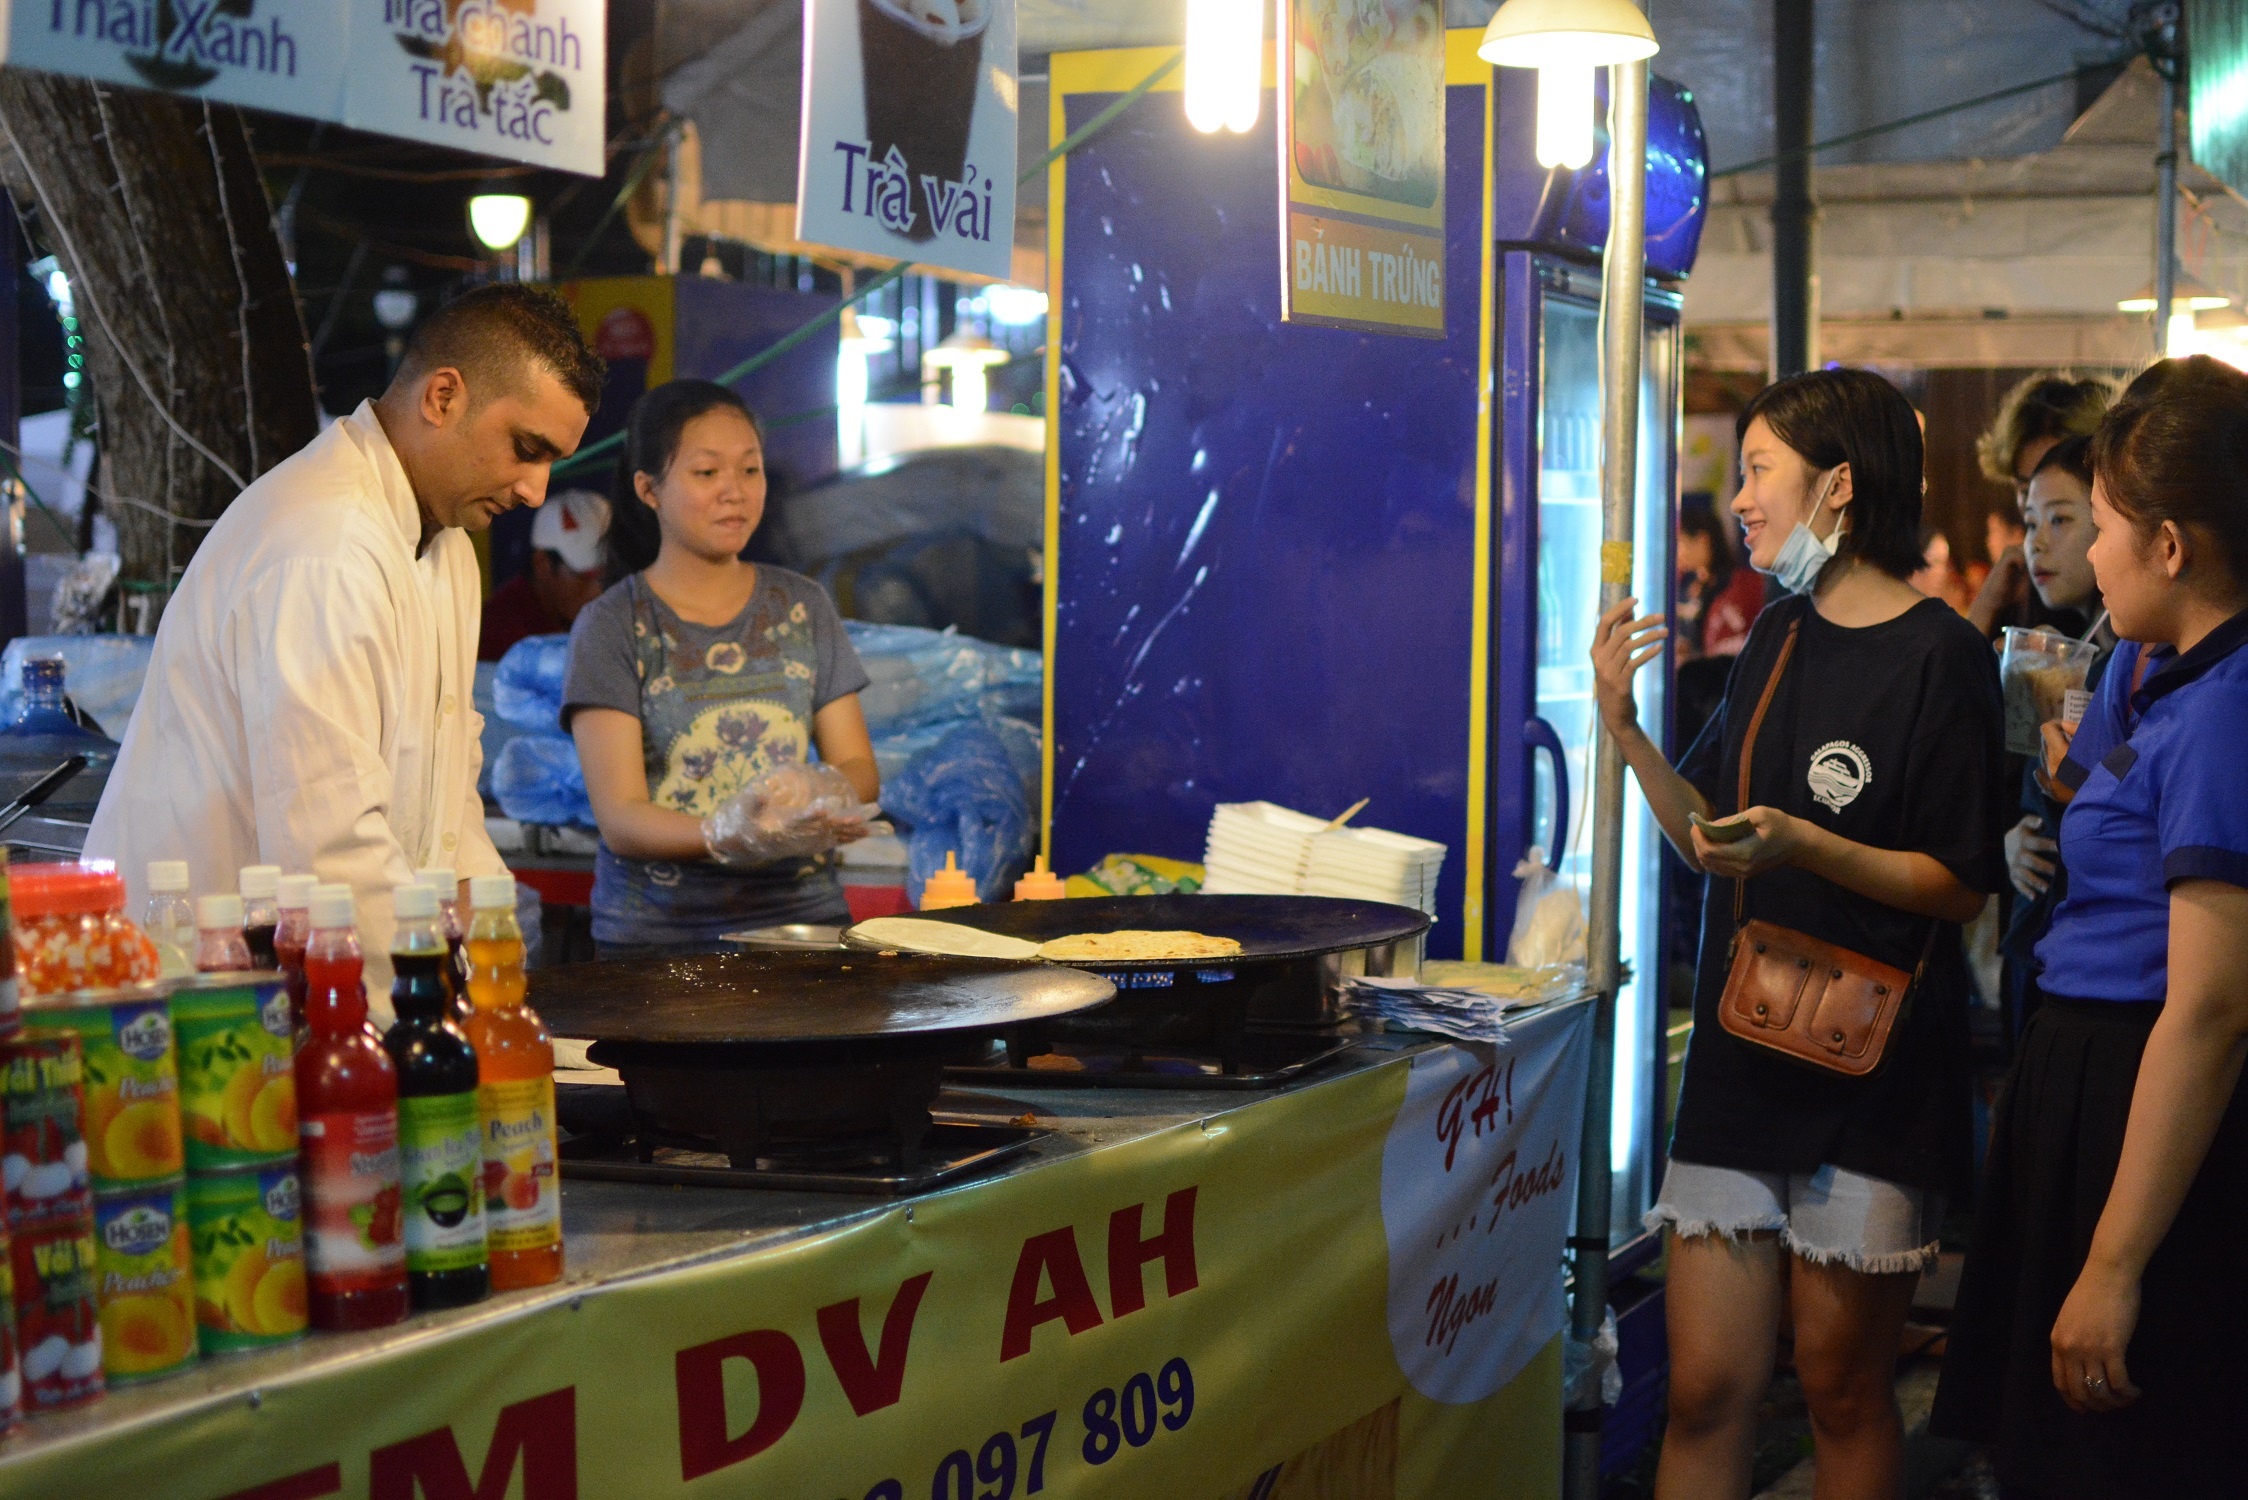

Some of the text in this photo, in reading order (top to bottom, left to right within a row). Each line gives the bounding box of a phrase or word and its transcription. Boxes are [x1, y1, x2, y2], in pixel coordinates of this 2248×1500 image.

[170, 0, 296, 77] Xanh
[460, 0, 580, 70] chanh
[410, 63, 553, 146] Trà tắc
[834, 140, 993, 242] Trà vải
[1367, 242, 1441, 309] TRỨNG
[1810, 740, 1873, 783] GALAPAGOS AGGRESSOR
[490, 1109, 543, 1140] Peach
[1488, 1139, 1565, 1233] Foods
[675, 1271, 933, 1482] DV
[1000, 1185, 1199, 1363] AH
[1426, 1273, 1498, 1357] Ngon
[931, 1356, 1195, 1500] 097 809
